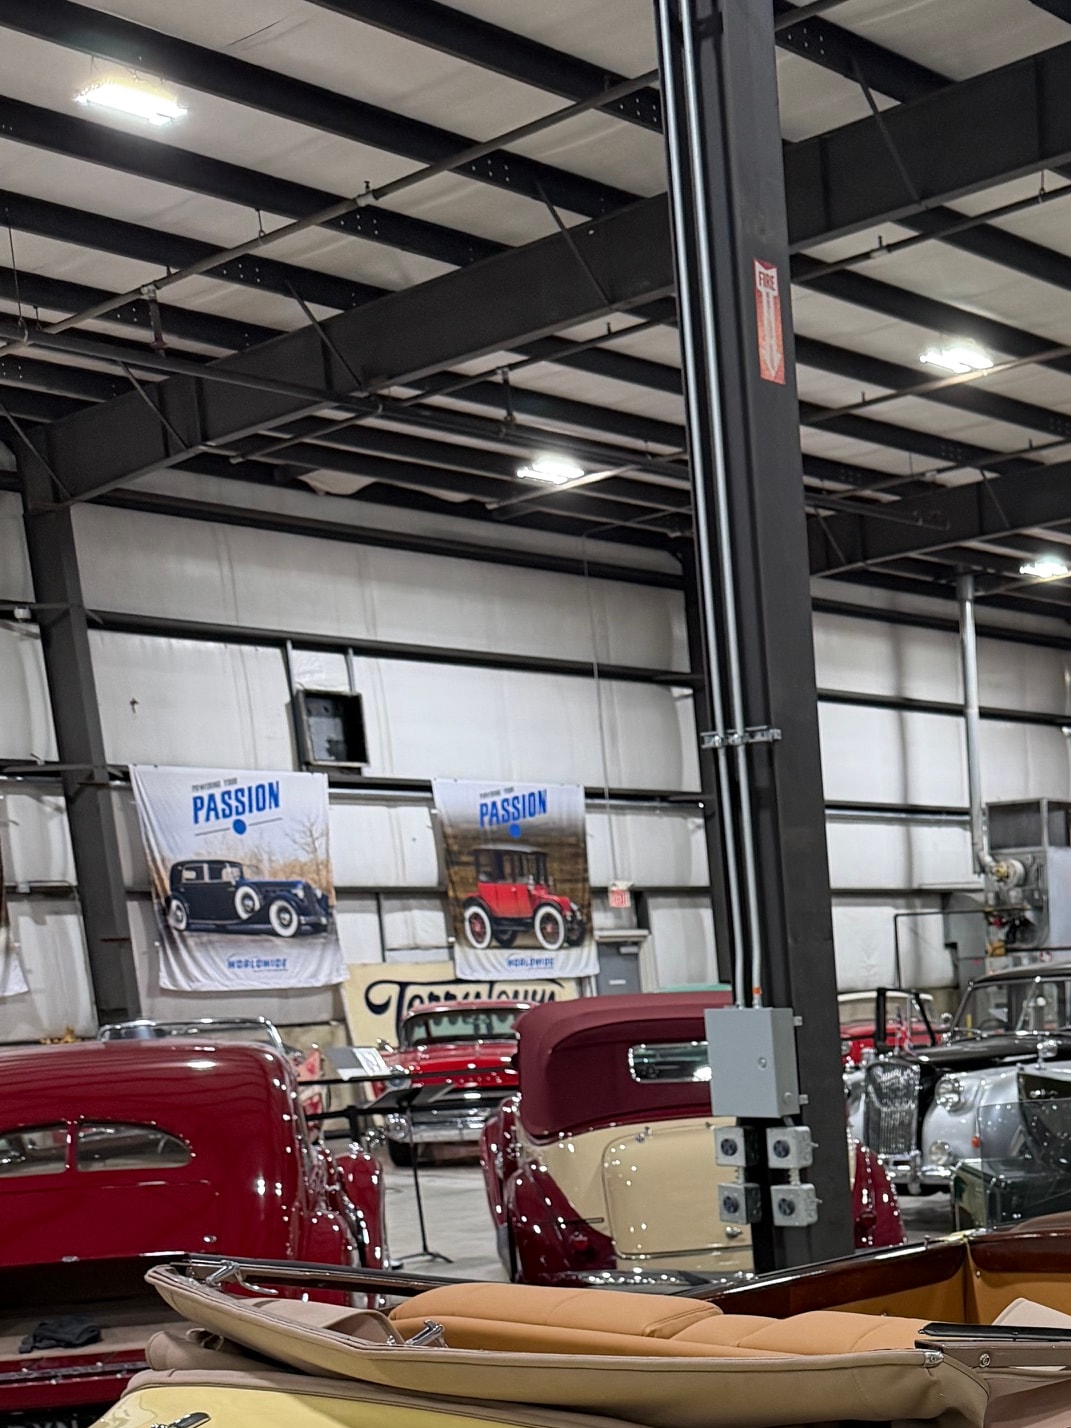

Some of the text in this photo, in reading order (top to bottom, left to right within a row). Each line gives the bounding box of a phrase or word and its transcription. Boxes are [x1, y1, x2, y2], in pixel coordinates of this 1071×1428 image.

[758, 271, 775, 291] FIRE
[193, 781, 279, 825] PASSION
[480, 789, 547, 828] PASSION
